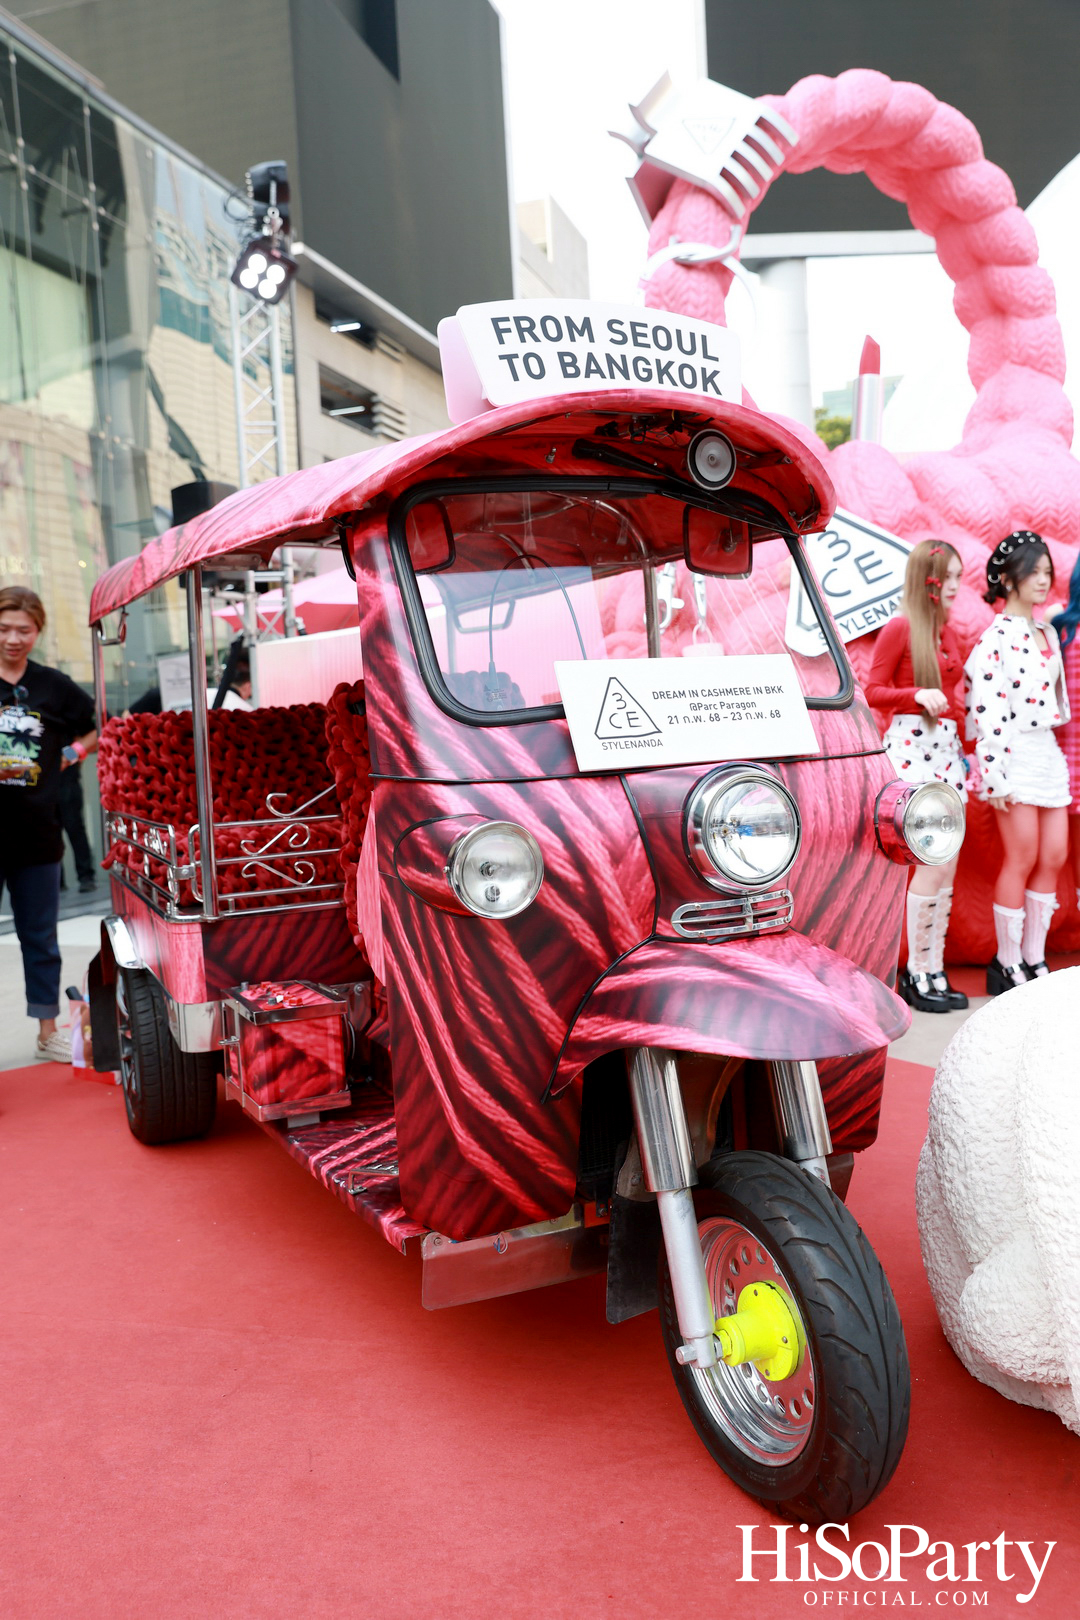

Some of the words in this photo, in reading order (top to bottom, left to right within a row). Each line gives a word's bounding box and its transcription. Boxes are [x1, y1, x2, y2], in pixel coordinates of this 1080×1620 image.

[490, 314, 596, 346] FROM
[606, 318, 720, 363] SEOUL
[497, 351, 546, 382] TO
[556, 350, 723, 396] BANGKOK
[817, 530, 851, 562] 3
[821, 550, 893, 598] CE
[612, 692, 627, 710] 3
[651, 689, 687, 700] DREAM
[688, 689, 700, 698] IN
[700, 686, 752, 698] CASHMERE
[752, 686, 764, 695] IN
[764, 685, 785, 695] BKK
[689, 702, 719, 712] @Parc
[719, 701, 757, 711] Paragon
[609, 711, 643, 729] CE
[667, 715, 680, 725] 21
[708, 712, 721, 723] 68
[730, 711, 743, 721] 23
[769, 709, 782, 719] 68
[601, 738, 664, 751] STYLENANDA
